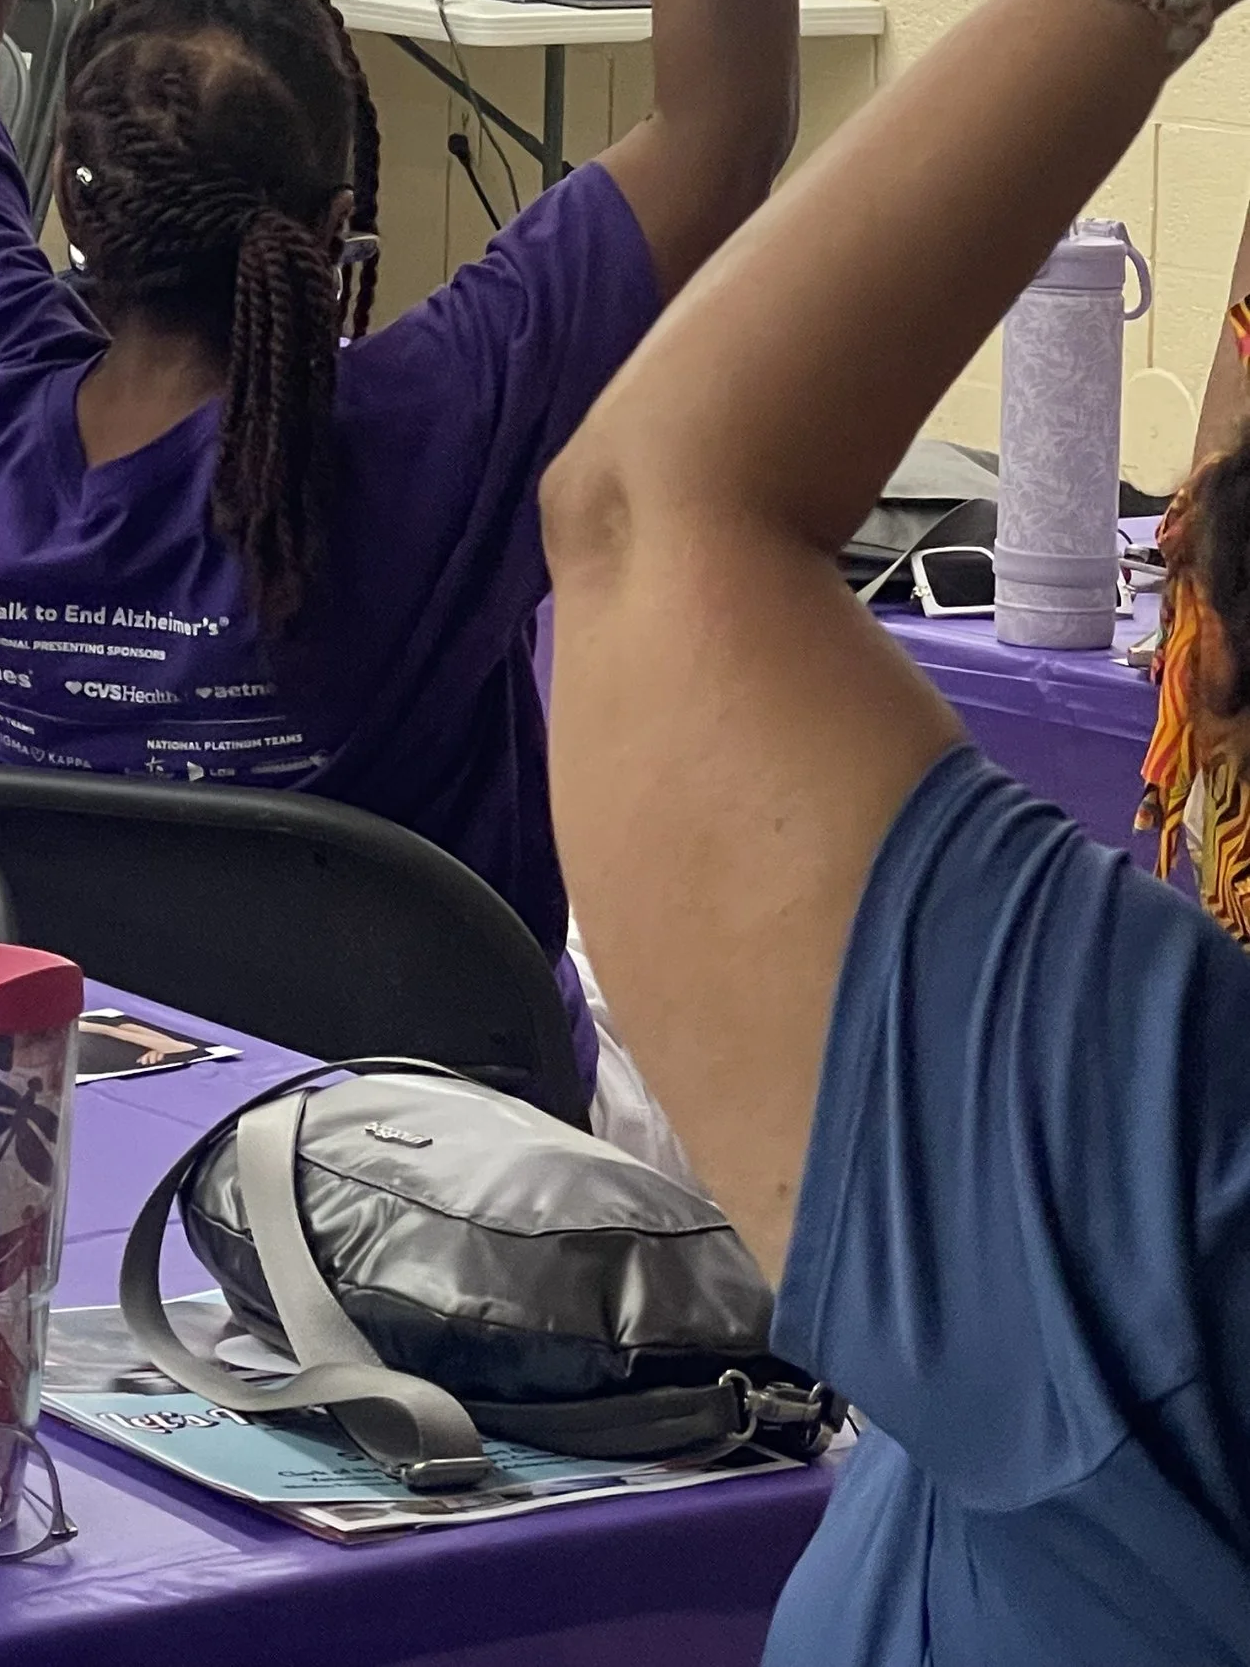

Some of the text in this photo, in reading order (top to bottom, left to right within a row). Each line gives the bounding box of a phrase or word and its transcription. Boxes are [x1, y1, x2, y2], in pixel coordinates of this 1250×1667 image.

[35, 605, 58, 622] to
[64, 604, 107, 625] End
[32, 640, 105, 656] PRESENTING
[106, 645, 166, 661] SPONSORS
[146, 733, 304, 752] NATIONAL PLATINUM TEAMS
